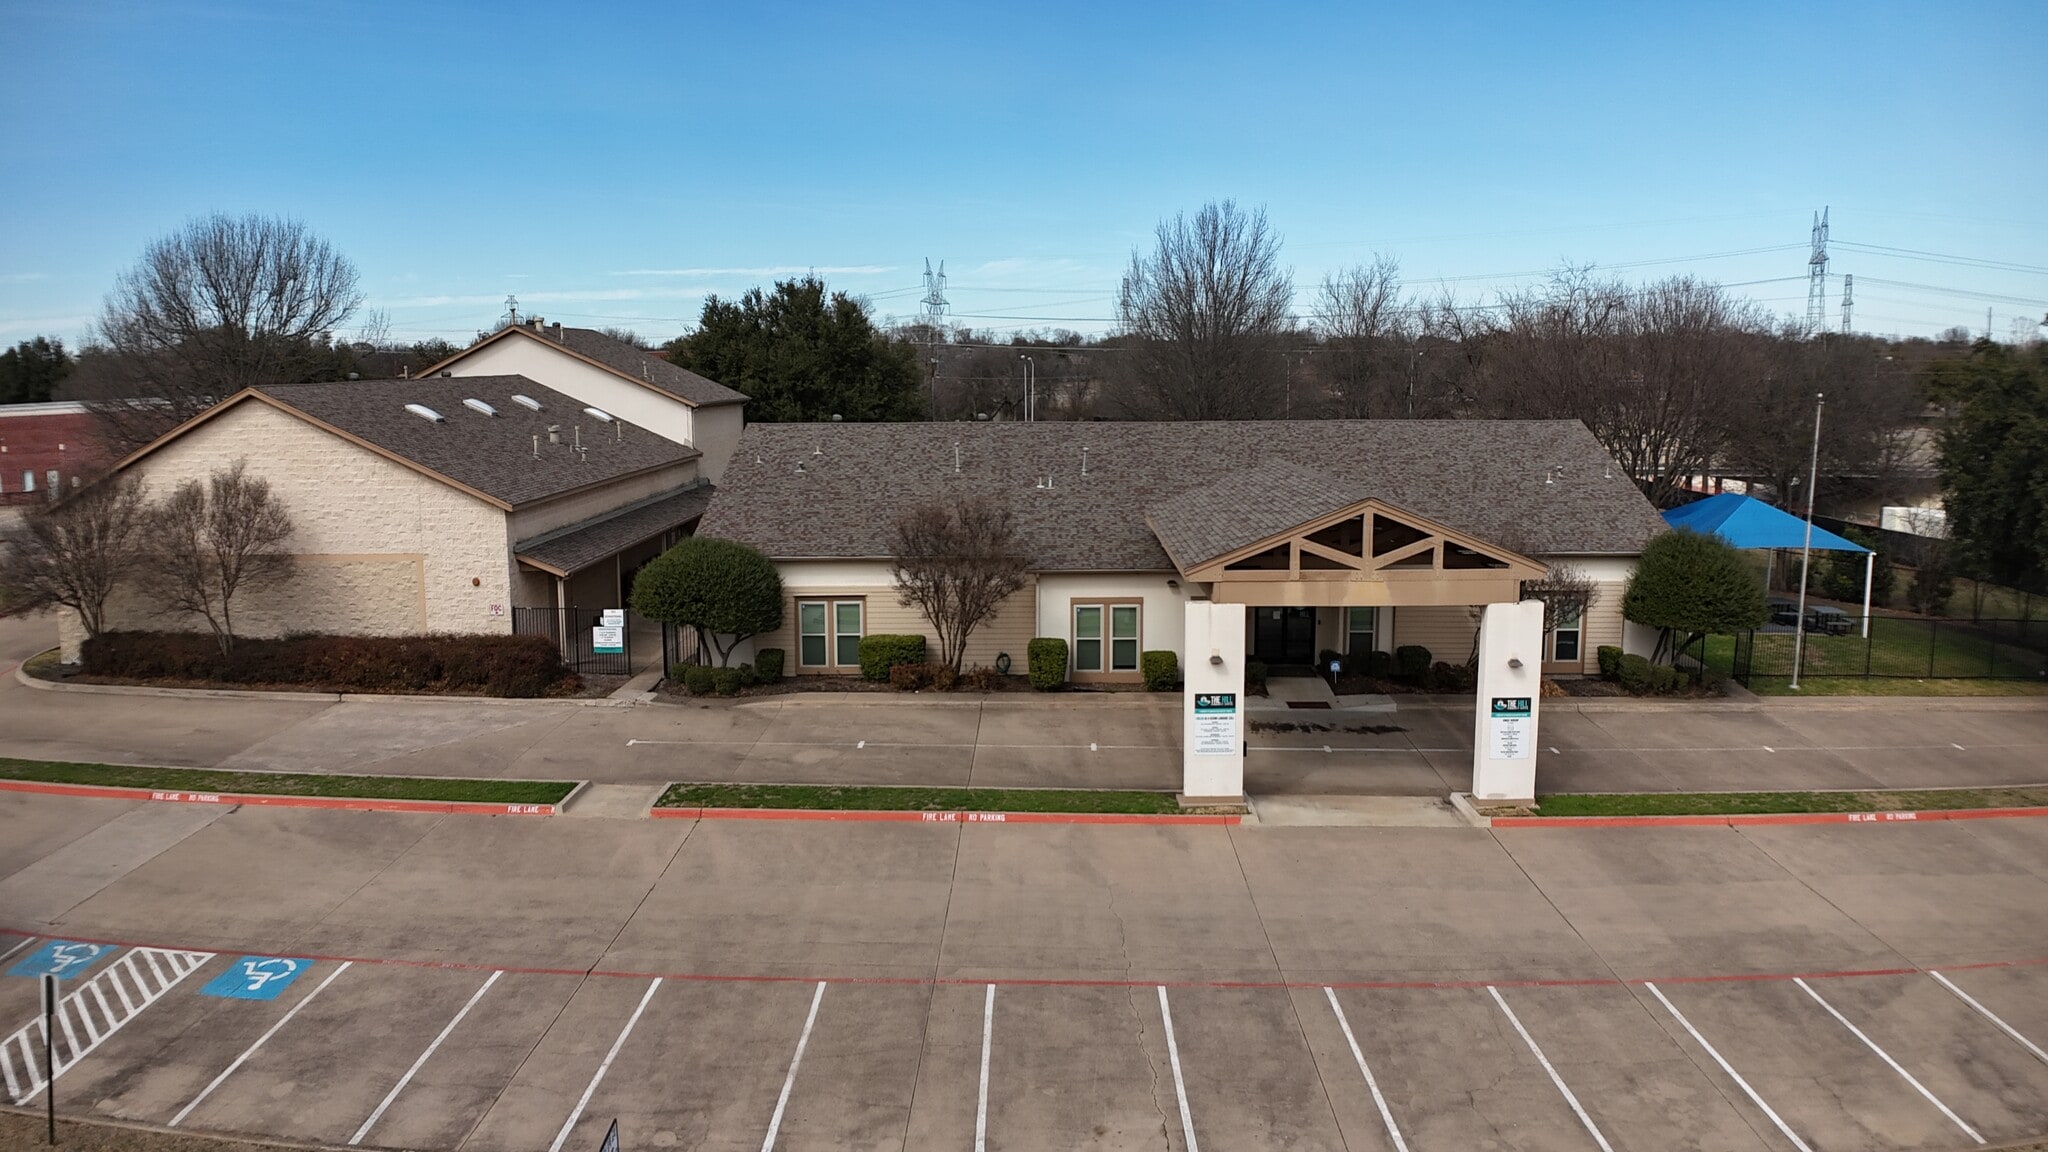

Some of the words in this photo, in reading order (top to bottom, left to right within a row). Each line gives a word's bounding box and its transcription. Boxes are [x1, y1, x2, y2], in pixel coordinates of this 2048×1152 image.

[1211, 695, 1221, 704] THE
[507, 805, 521, 813] FIRE
[523, 806, 539, 814] LANE
[922, 813, 937, 821] FIRE
[939, 813, 956, 821] LANE
[968, 813, 978, 821] NO
[979, 814, 1005, 822] PARKING
